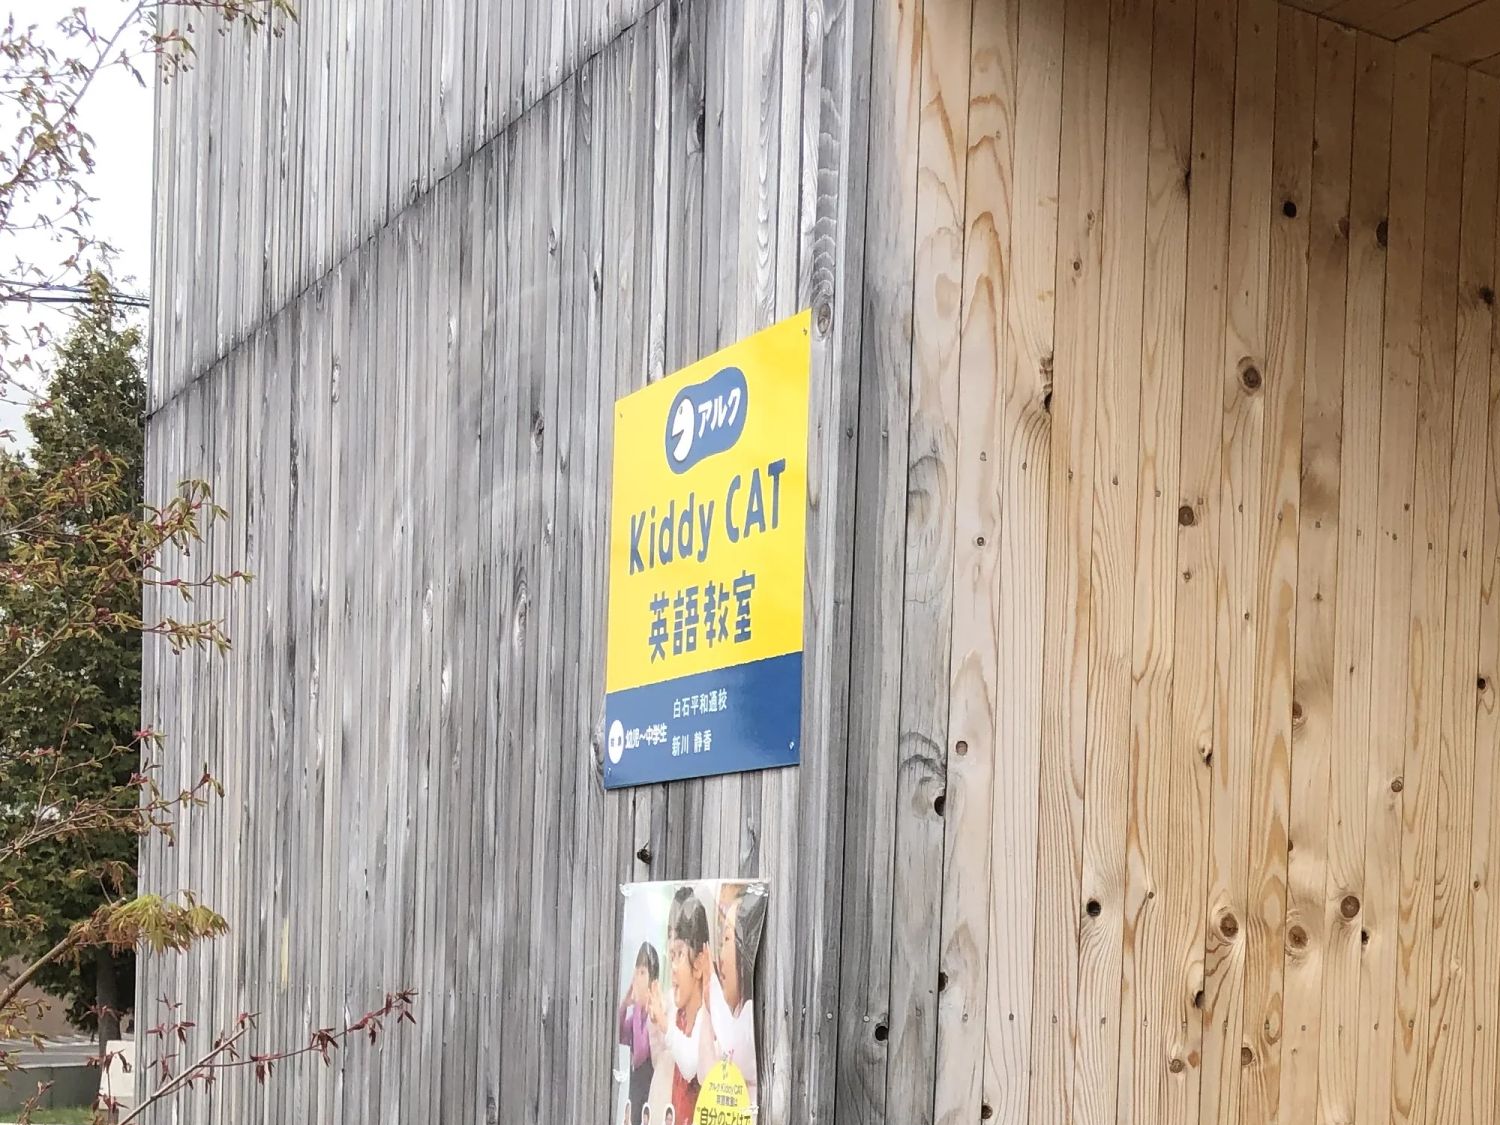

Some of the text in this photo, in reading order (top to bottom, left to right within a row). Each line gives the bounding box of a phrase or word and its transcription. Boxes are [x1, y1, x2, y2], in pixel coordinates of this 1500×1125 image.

[698, 387, 742, 439] アルク
[629, 457, 787, 576] Kiddy CAT
[648, 569, 756, 665] 英語教室
